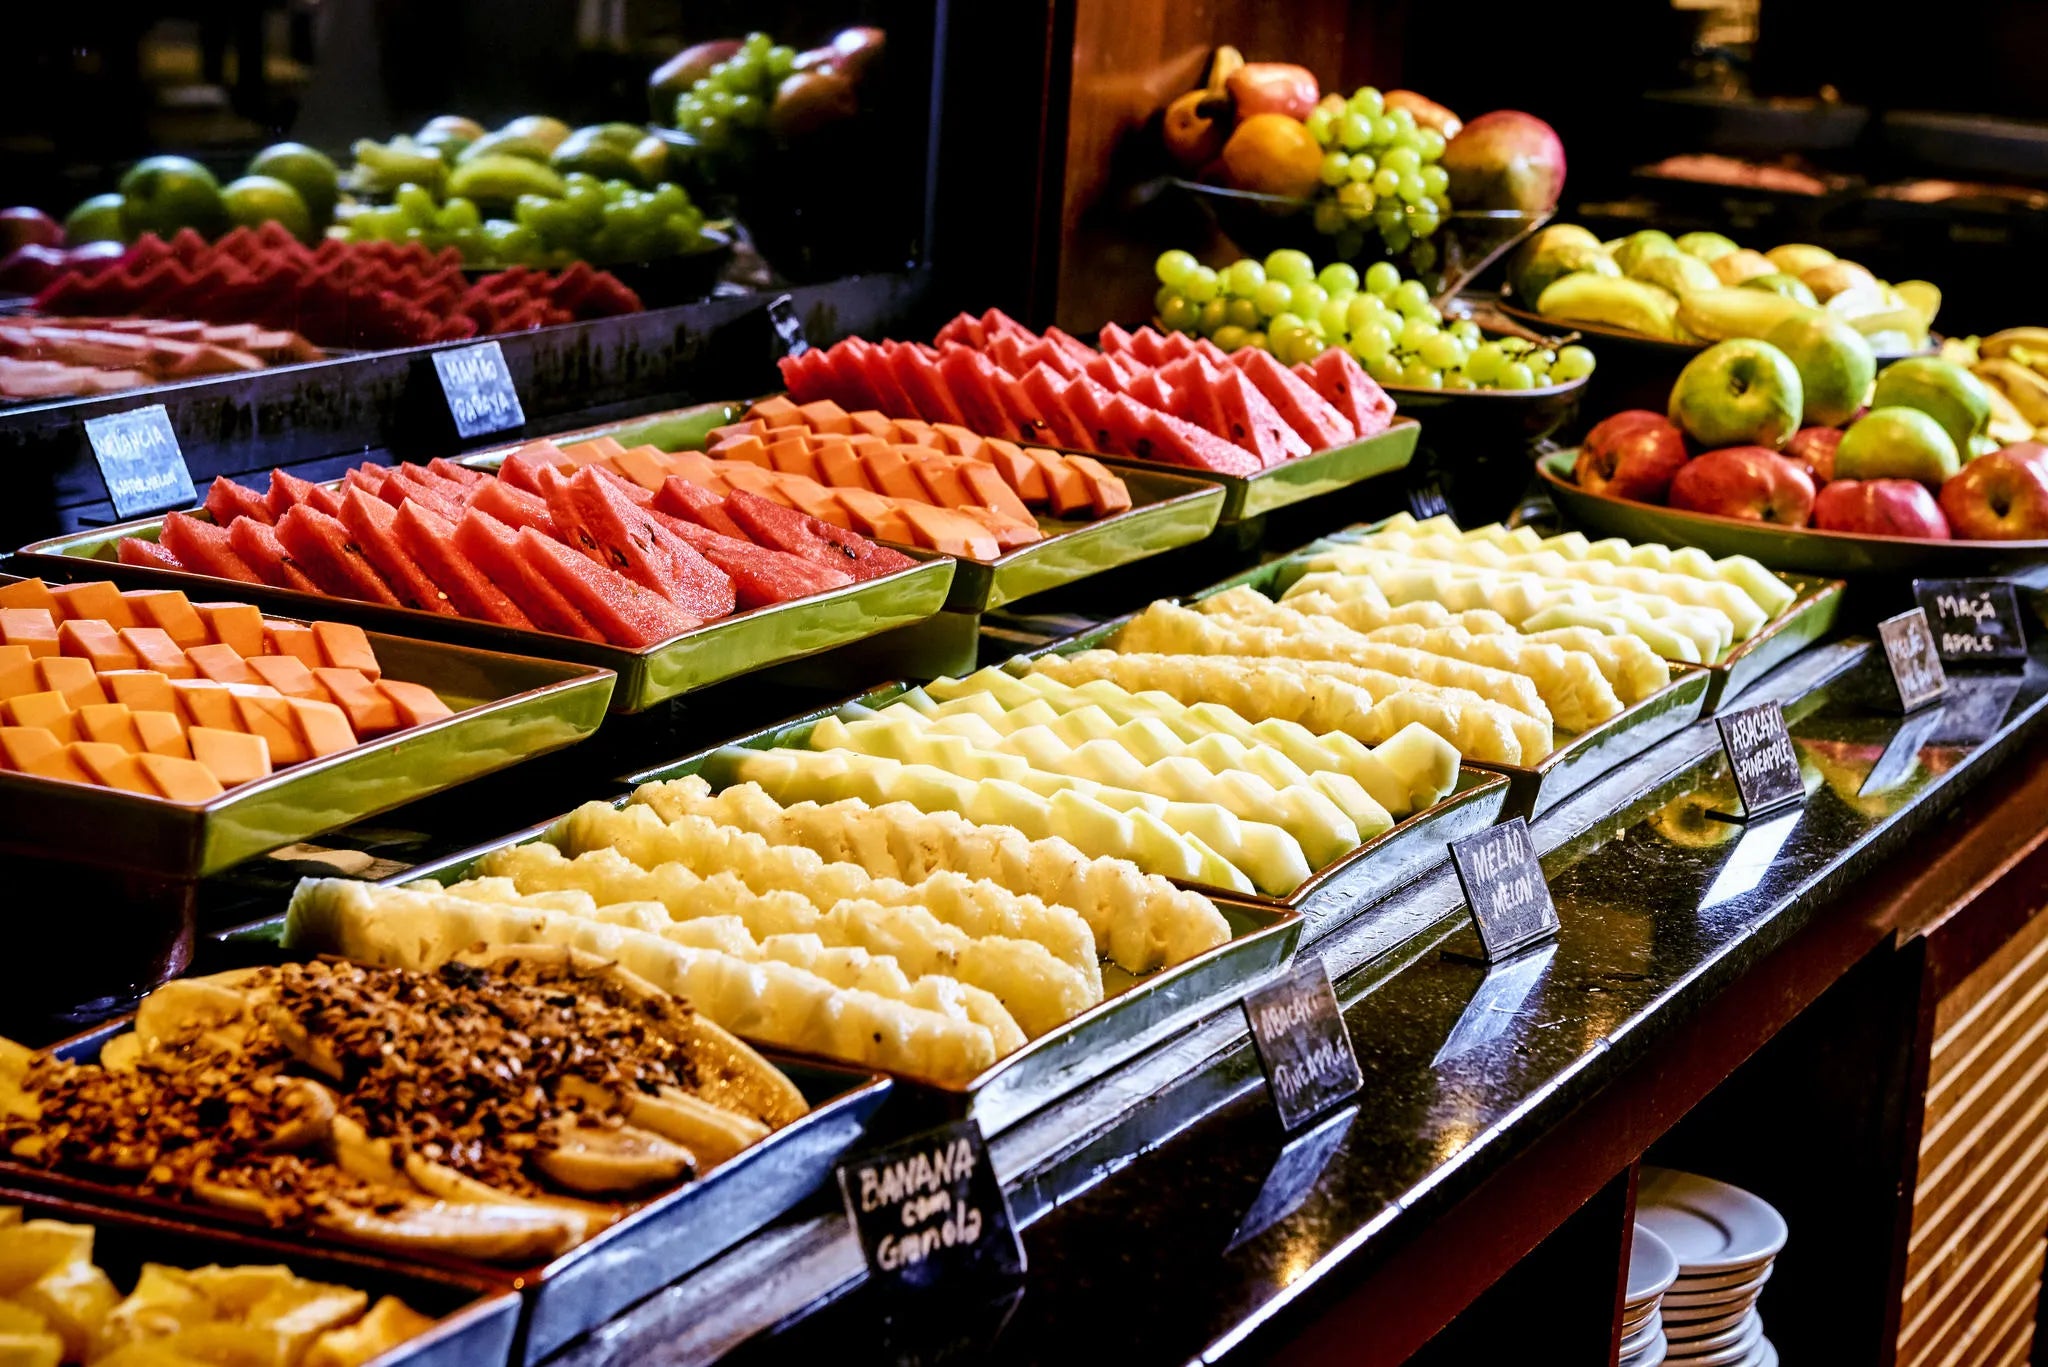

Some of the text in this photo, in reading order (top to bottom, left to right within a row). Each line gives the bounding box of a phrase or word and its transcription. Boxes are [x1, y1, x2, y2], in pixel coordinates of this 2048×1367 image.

[454, 391, 511, 423] PAPAYA
[1733, 706, 1781, 752] ABACAXI
[1740, 737, 1791, 782] PINEAPPLE
[1492, 873, 1533, 919] MELON
[859, 1138, 976, 1212] BANANA
